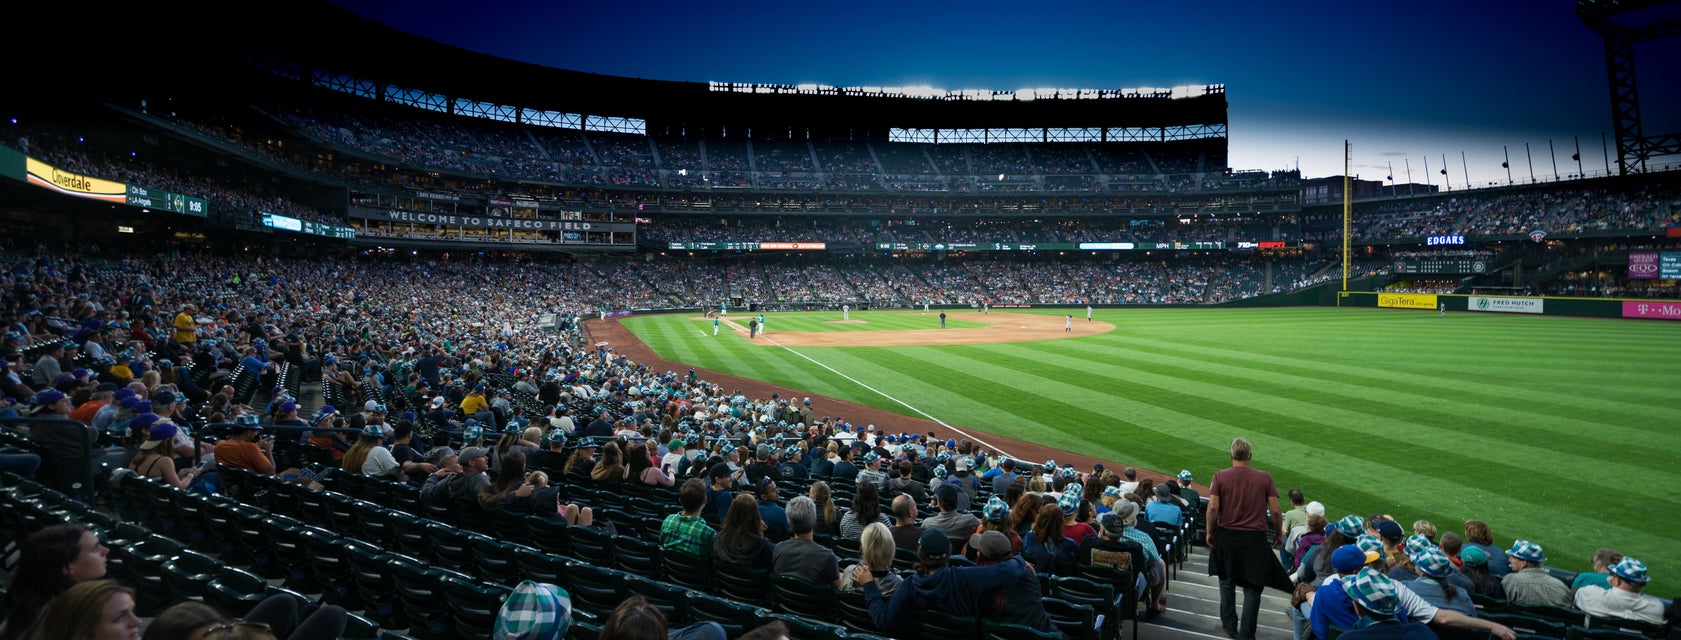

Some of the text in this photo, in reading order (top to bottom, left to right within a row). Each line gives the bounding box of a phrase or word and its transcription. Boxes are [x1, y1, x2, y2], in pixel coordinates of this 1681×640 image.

[52, 168, 91, 192] Cloverdale
[131, 186, 139, 194] Chi
[132, 196, 152, 207] LA Angels
[189, 200, 202, 212] 9:05
[388, 210, 592, 231] WELCOME TO SAFECO FIELD
[1427, 235, 1465, 246] EDGARS
[1629, 264, 1658, 273] EQC
[1380, 296, 1415, 306] GigaTera
